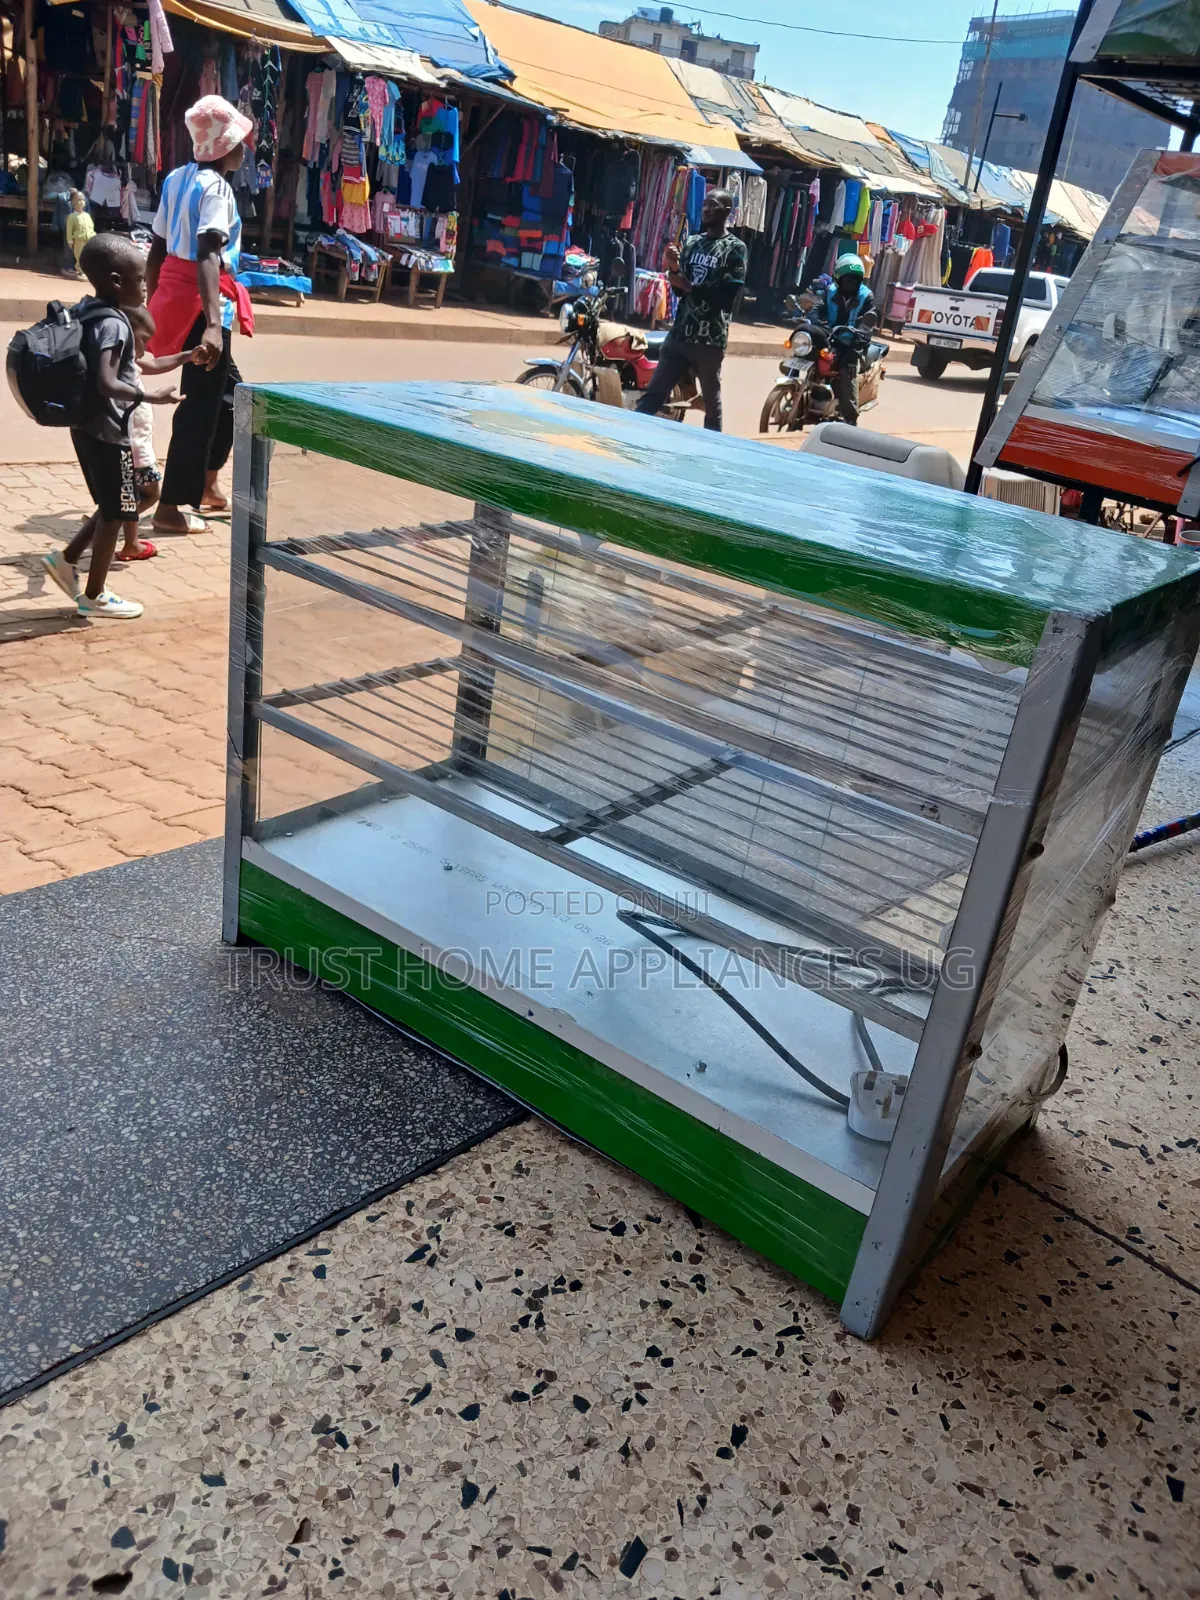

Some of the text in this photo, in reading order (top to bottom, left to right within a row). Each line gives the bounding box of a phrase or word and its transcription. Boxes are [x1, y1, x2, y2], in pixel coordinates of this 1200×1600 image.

[932, 311, 977, 328] OYOTA
[454, 863, 488, 882] YEARS
[574, 923, 592, 934] 05
[595, 934, 614, 946] 26
